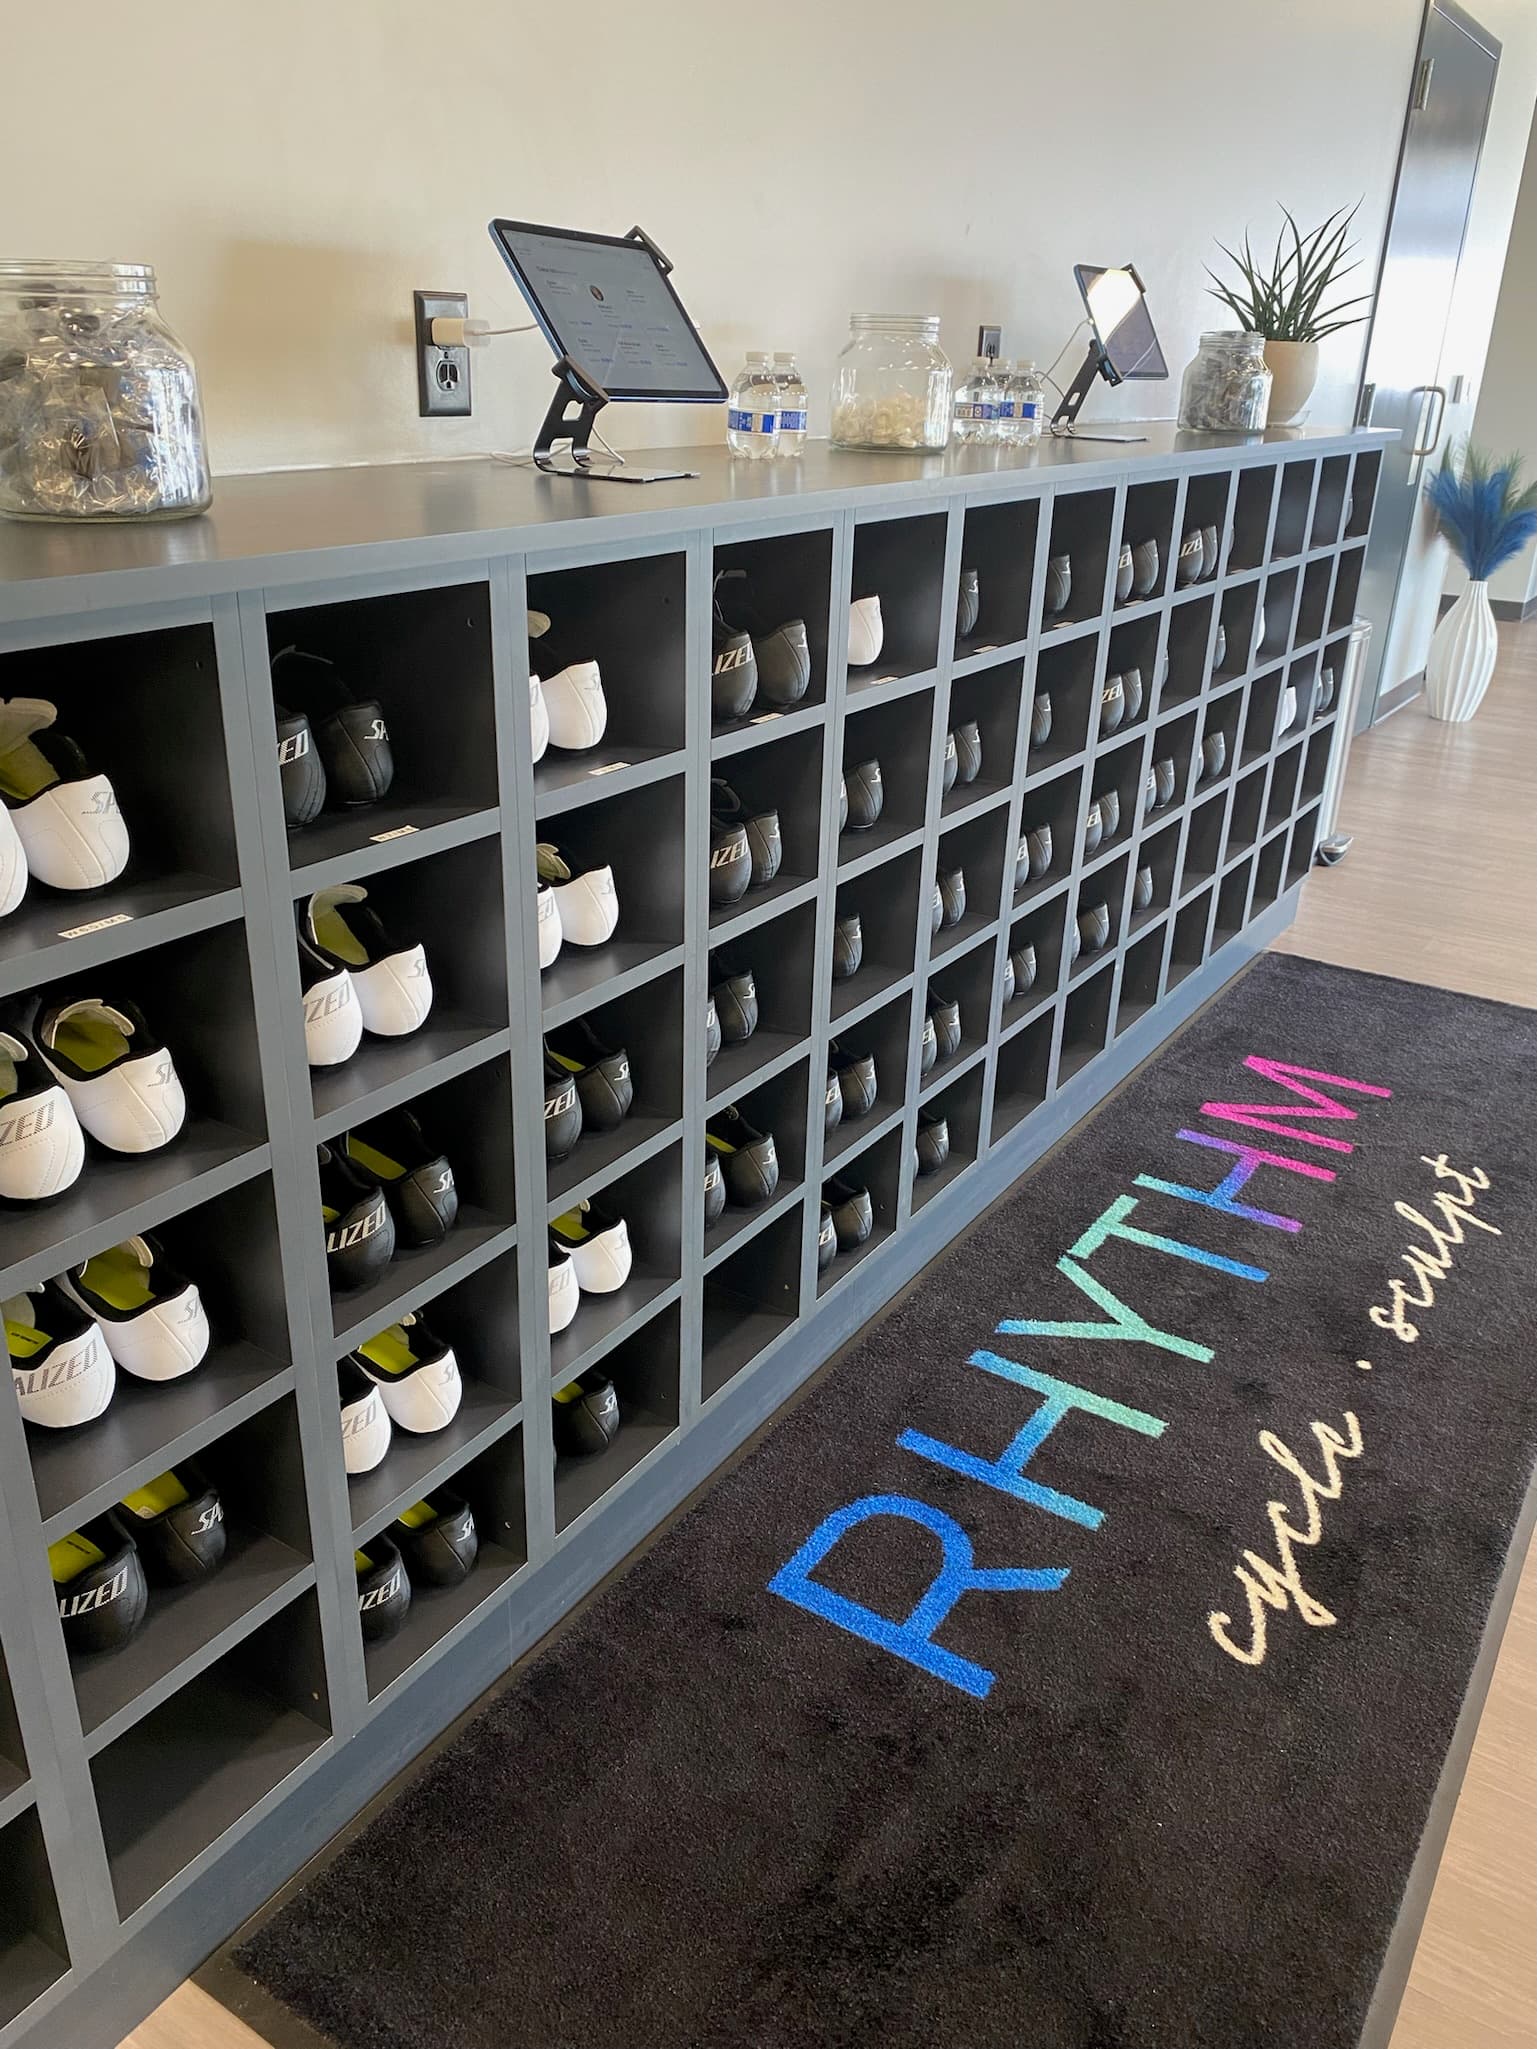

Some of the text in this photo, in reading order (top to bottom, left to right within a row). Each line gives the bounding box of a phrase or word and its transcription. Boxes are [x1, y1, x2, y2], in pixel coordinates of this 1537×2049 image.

[767, 1055, 1393, 1699] RHYTHM
[1208, 1153, 1502, 1666] cycle sculpt
